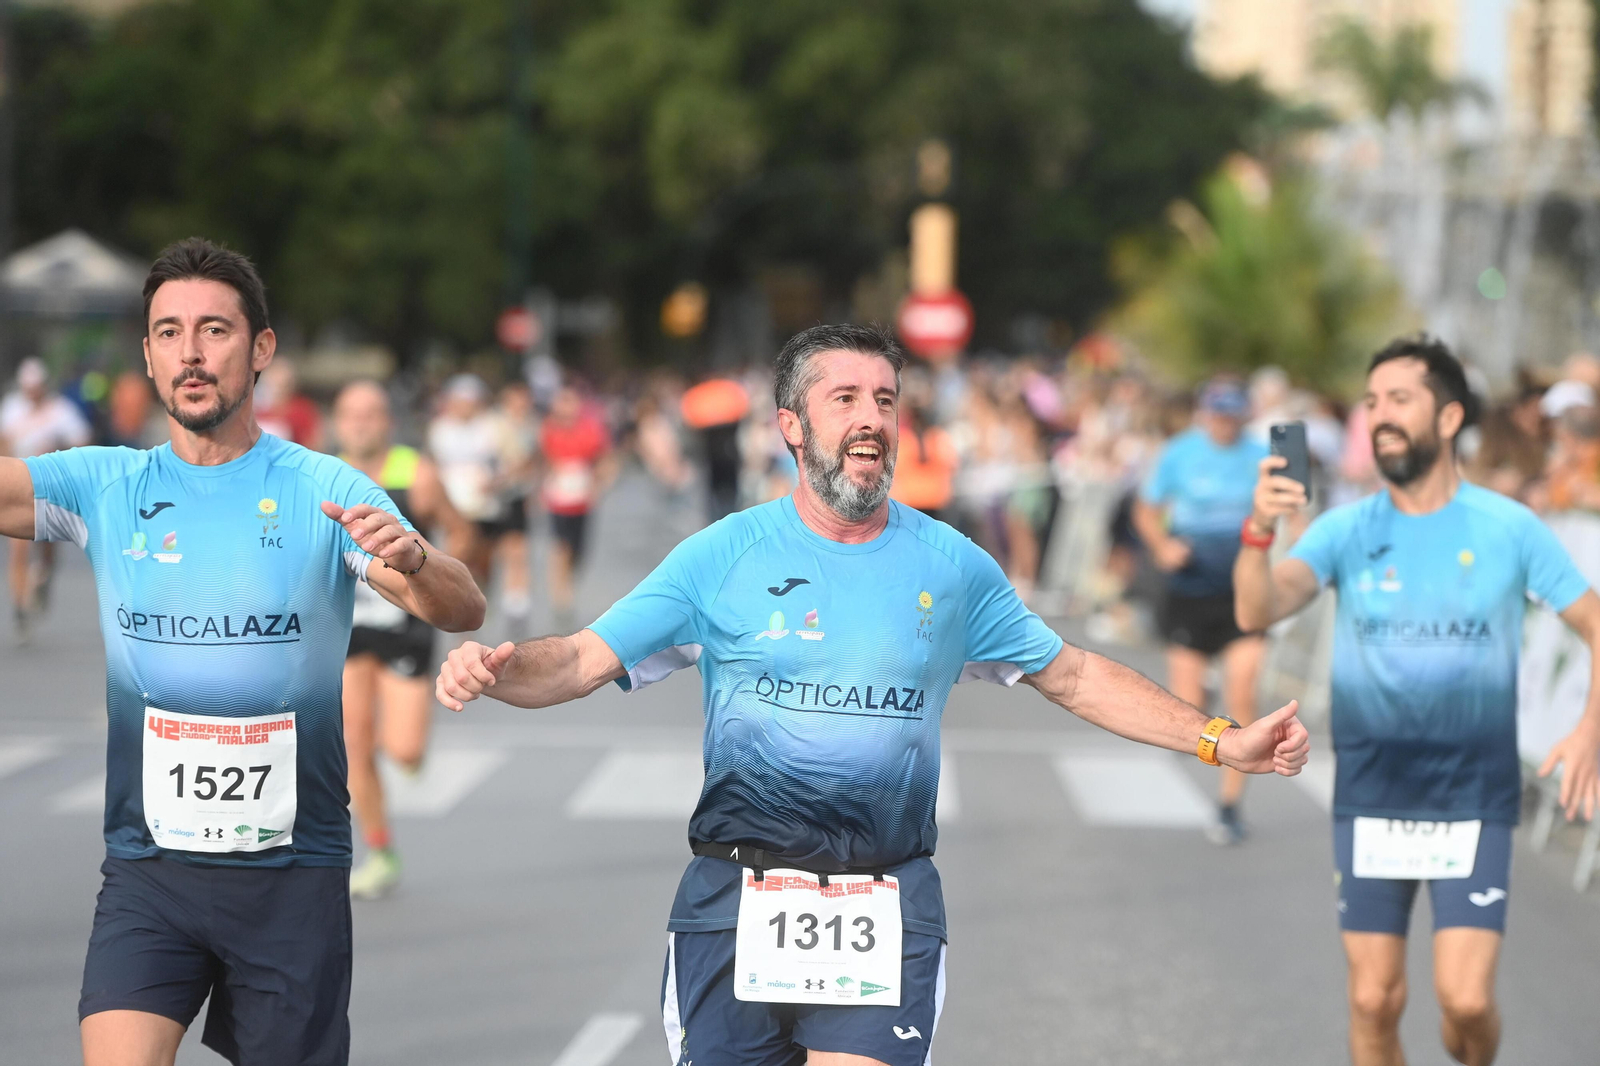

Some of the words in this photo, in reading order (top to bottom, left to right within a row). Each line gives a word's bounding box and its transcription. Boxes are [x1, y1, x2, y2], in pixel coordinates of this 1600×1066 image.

[259, 536, 284, 549] TAC
[116, 603, 302, 638] ÓPTICALAZA
[915, 628, 933, 642] TAC
[148, 715, 181, 741] 42
[181, 721, 241, 735] CARRERA
[244, 719, 293, 735] URBANA
[181, 732, 210, 741] CIUDAD
[169, 763, 272, 801] 1527
[747, 874, 784, 892] 42
[784, 876, 843, 892] CARRRA
[769, 911, 876, 953] 1313
[767, 980, 796, 990] málaga
